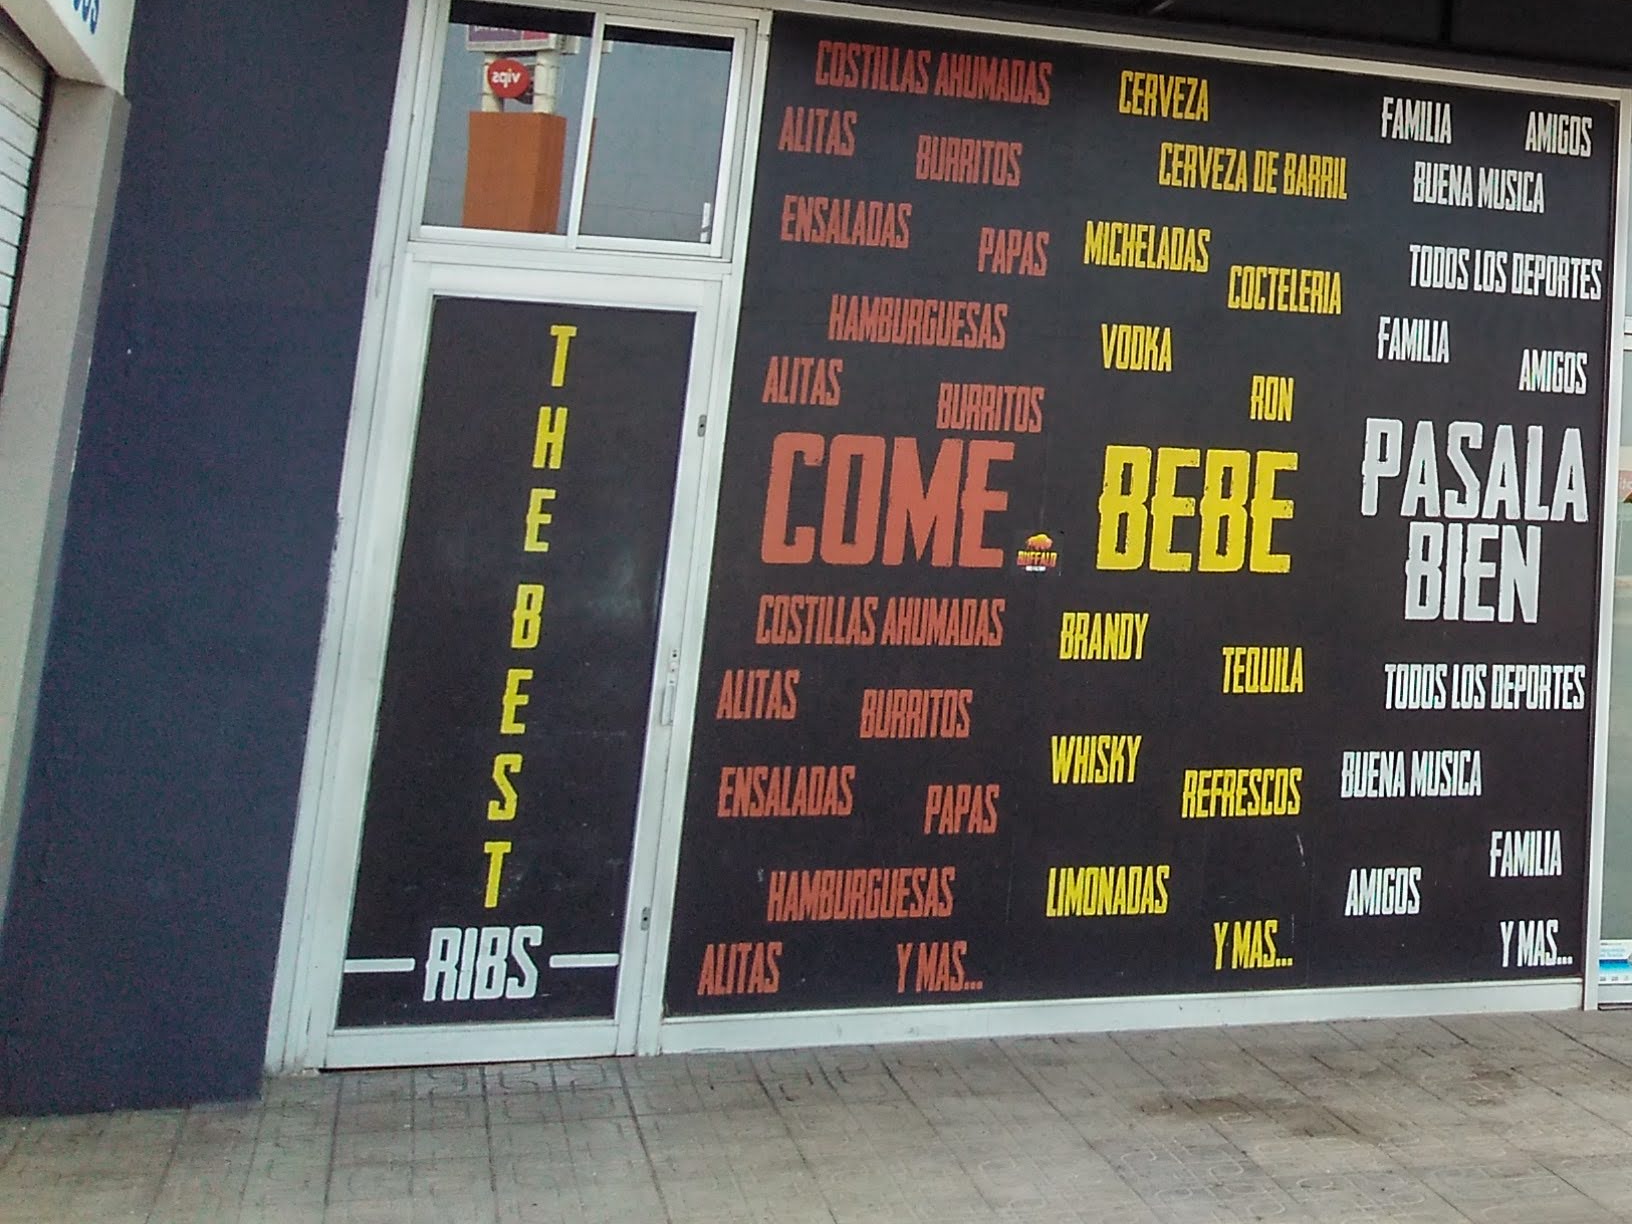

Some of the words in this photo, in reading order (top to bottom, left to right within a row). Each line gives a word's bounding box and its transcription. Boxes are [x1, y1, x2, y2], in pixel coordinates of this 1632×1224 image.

[816, 40, 931, 94] COSTILLAS
[934, 53, 1052, 105] AHUMADAS
[1120, 72, 1208, 120] CERVEZA
[779, 106, 857, 157] ALITAS
[1382, 97, 1451, 144] FAMILIA
[1525, 112, 1592, 157] AMIGOS
[916, 135, 1023, 187] BURRITOS
[1159, 142, 1248, 191] CERVEZA
[1254, 151, 1278, 193] DE
[1284, 153, 1346, 199] BARRIL
[1414, 162, 1472, 206] BUENA
[1478, 168, 1544, 213] MUSICA
[781, 195, 912, 248] ENSALADAS
[978, 227, 1049, 276] PAPAS
[1084, 222, 1210, 272] MICHELADAS
[1228, 266, 1341, 313] COCTELERIA
[1410, 245, 1469, 289] TODOS
[1474, 250, 1507, 292] LOS
[1512, 253, 1602, 299] DEPORTES
[828, 296, 1008, 349] HAMBURGUESAS
[1102, 324, 1171, 370] VODKA
[1378, 317, 1449, 363] FAMILIA
[763, 357, 843, 405] ALITAS
[1519, 349, 1587, 394] AMIGOS
[937, 383, 1044, 432] BURRITOS
[1251, 376, 1294, 420] RON
[523, 324, 578, 552] THE
[1361, 418, 1588, 522] PASALA
[762, 433, 1014, 568] COME
[1098, 446, 1297, 572] BEBE
[1405, 522, 1541, 623] BIEN
[757, 595, 878, 645] COSTILLAS
[881, 599, 1005, 646] AHUMADAS
[1060, 612, 1148, 659] BRANDY
[717, 669, 799, 719] ALITAS
[1224, 648, 1303, 693] TEQUILA
[1385, 664, 1447, 709] TODOS
[1452, 664, 1487, 709] LOS
[1491, 665, 1585, 709] DEPORTES
[860, 690, 972, 738] BURRITOS
[482, 583, 545, 909] BEST
[1052, 735, 1140, 783] WHISKY
[719, 765, 855, 817] ENSALADAS
[1182, 768, 1302, 817] REFRESCOS
[1341, 751, 1405, 797] BUENA
[1411, 751, 1481, 796] MUSICA
[924, 784, 999, 833] PAPAS
[1490, 831, 1561, 877] FAMILIA
[768, 867, 955, 921] HAMBURGUESAS
[1048, 866, 1169, 915] LIMONADAS
[1345, 867, 1421, 916] AMIGOS
[423, 926, 542, 1001] RIBS
[698, 942, 782, 995] ALITAS
[897, 943, 912, 992] Y
[1215, 922, 1228, 968] Y
[1501, 921, 1514, 967] Y
